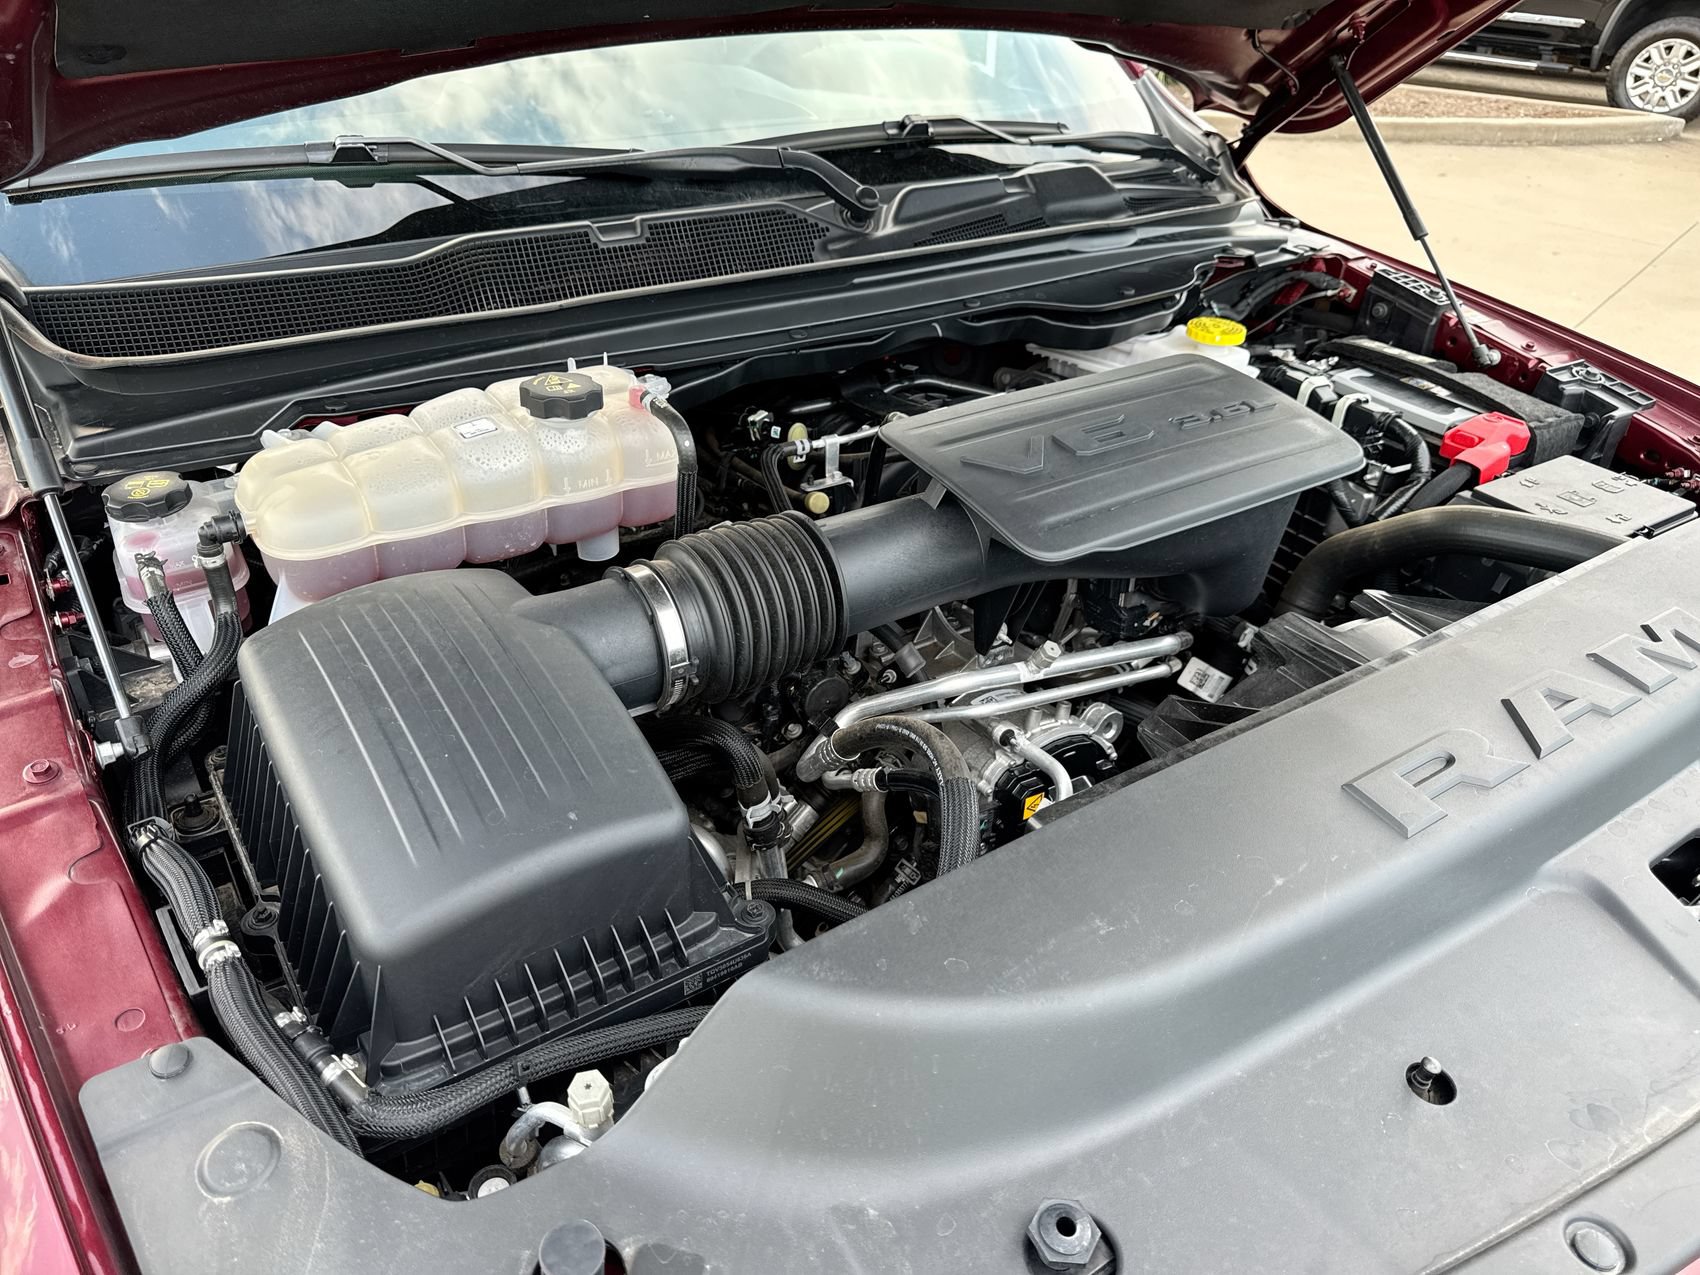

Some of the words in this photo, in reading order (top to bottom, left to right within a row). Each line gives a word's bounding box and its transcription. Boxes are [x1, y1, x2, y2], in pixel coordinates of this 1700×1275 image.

[959, 411, 1156, 476] V6
[1167, 399, 1279, 431] 3.6L
[1341, 606, 1700, 839] RAM
